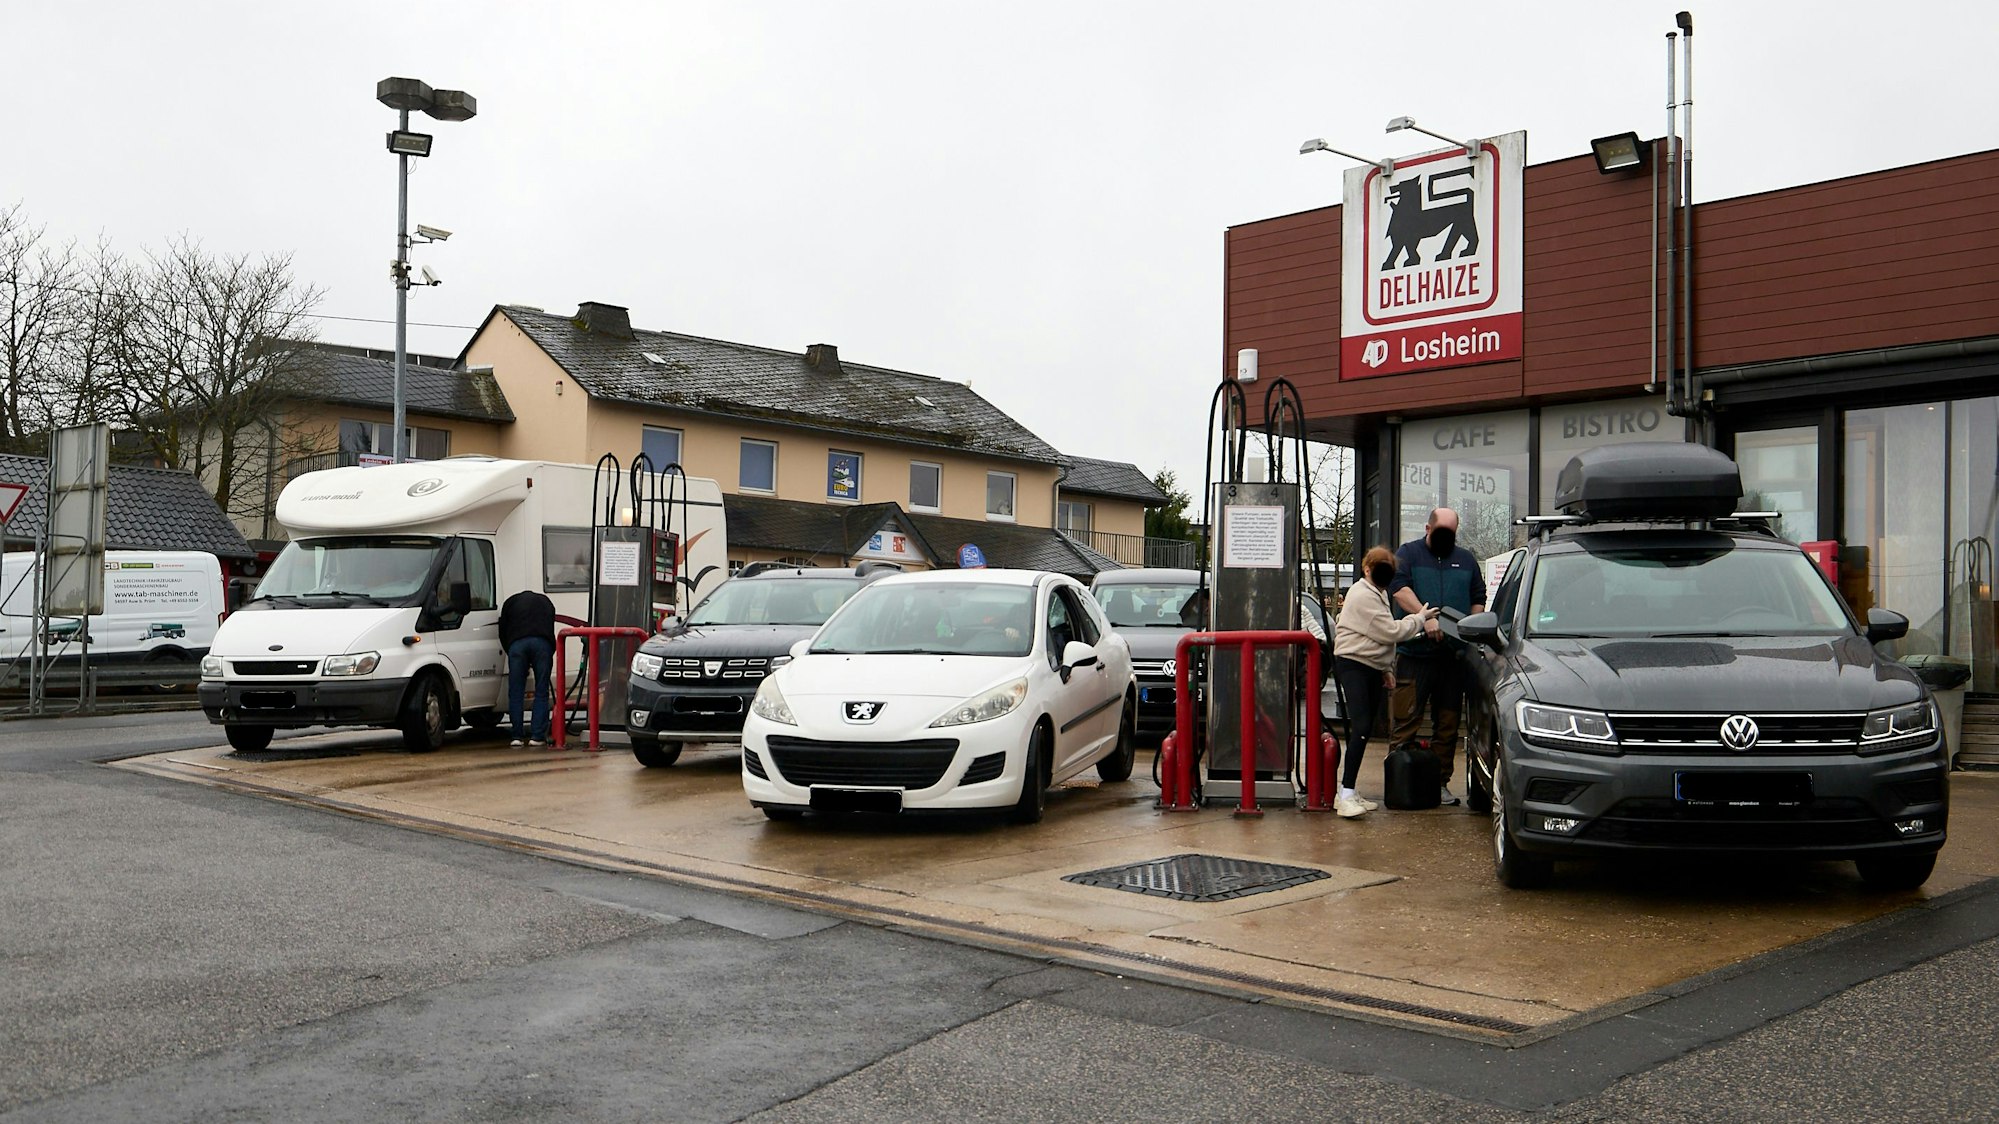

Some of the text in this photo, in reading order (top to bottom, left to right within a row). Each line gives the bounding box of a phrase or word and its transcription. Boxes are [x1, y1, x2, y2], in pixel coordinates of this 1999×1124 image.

[1379, 262, 1481, 310] DELHAIZE
[1361, 327, 1500, 368] AD Losheim
[1433, 423, 1496, 450] CAFE
[1563, 408, 1660, 439] BISTRO
[1228, 485, 1237, 497] 3
[1270, 486, 1278, 498] 4
[631, 528, 638, 537] 2
[114, 590, 198, 598] www.tab-maschinen.de
[1720, 714, 1759, 751] VW
